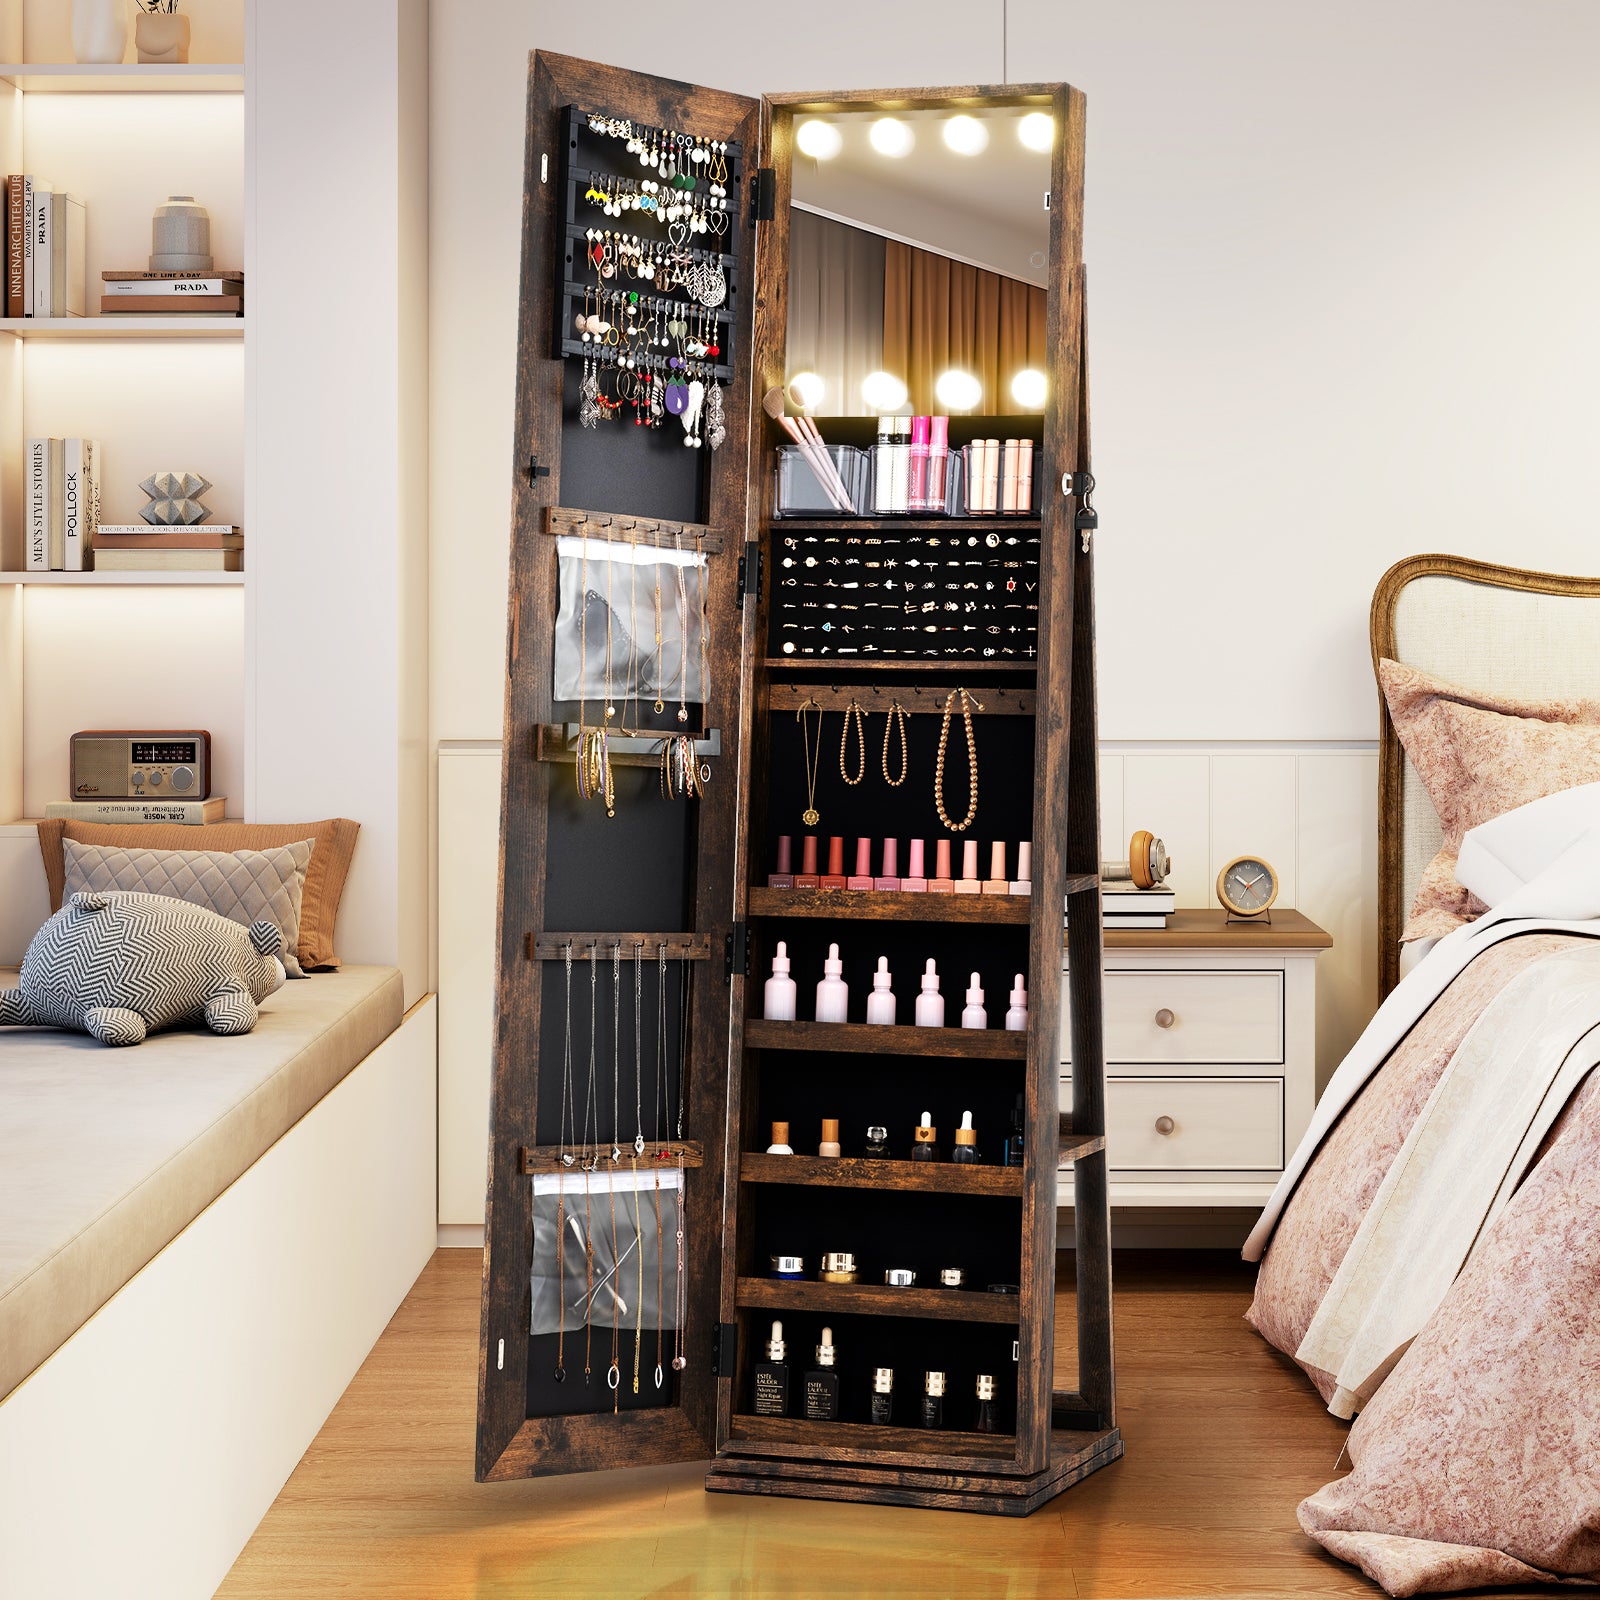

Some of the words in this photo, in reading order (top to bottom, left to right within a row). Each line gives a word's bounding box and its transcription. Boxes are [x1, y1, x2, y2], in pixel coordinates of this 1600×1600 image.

[11, 175, 22, 298] INNENARCHITEKTUR
[174, 283, 209, 291] PRADA
[33, 443, 43, 491] STORIES
[33, 492, 43, 527] STYLE
[67, 472, 77, 537] POLLOCK
[33, 529, 43, 563] MEN'S
[152, 806, 185, 814] Architektur
